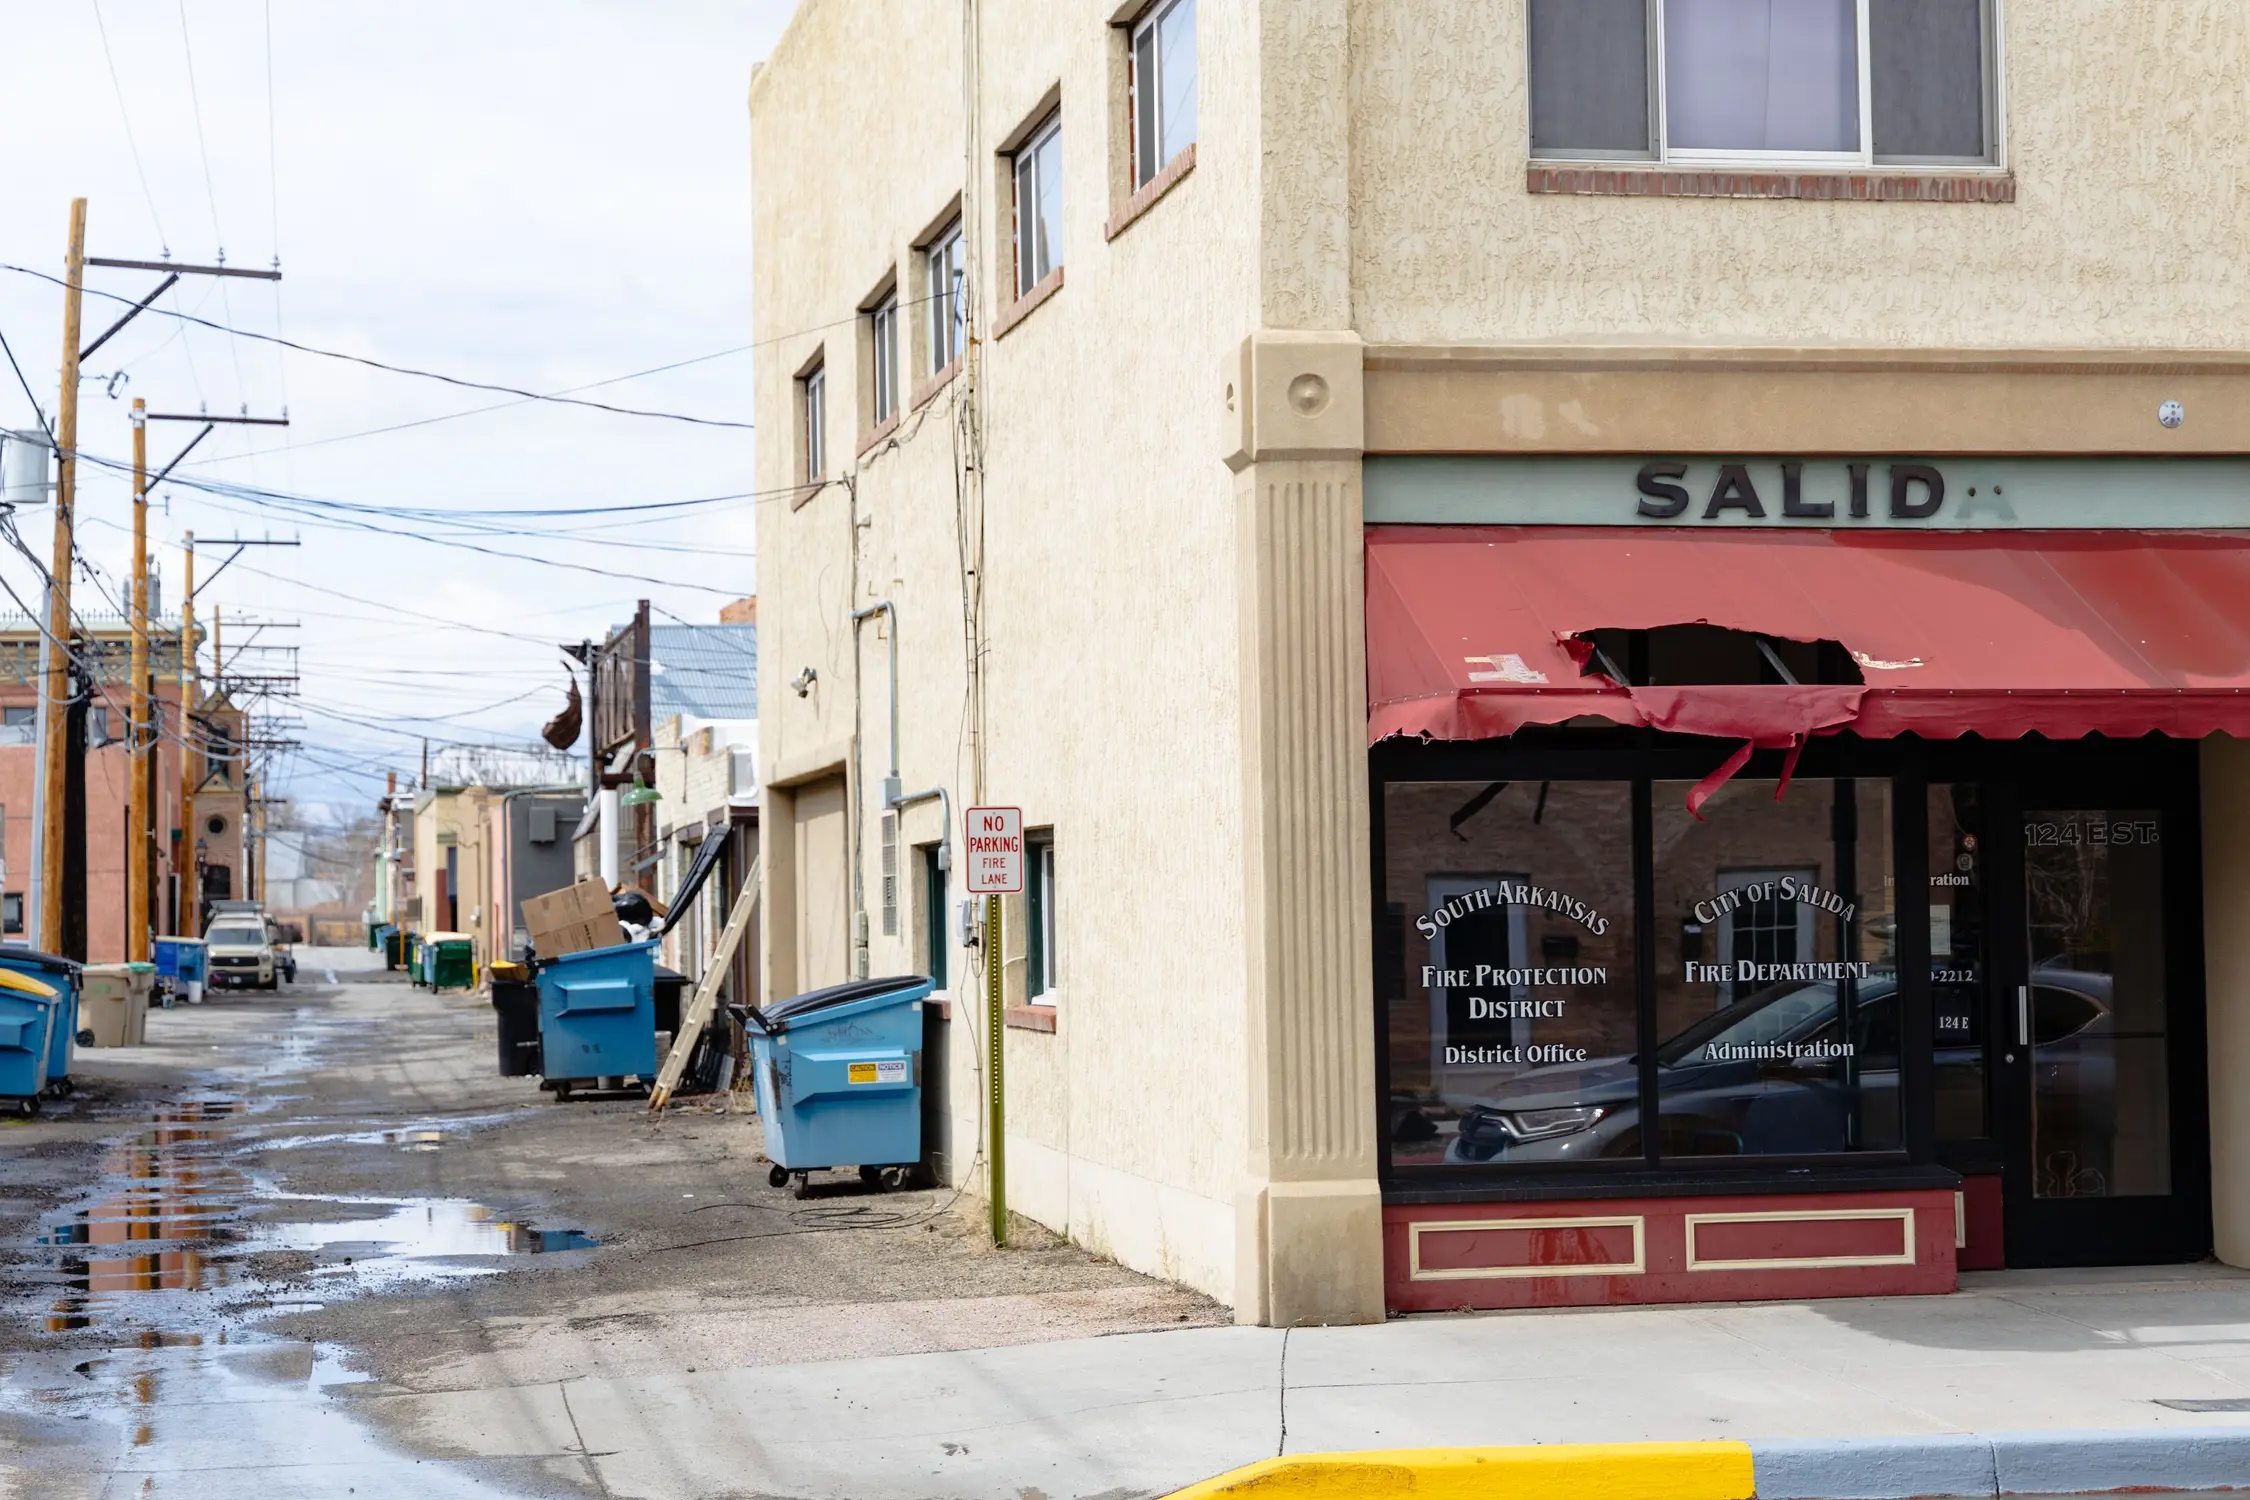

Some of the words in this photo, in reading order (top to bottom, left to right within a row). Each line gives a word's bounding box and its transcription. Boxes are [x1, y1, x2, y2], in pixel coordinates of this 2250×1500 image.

[983, 815, 1004, 832] NO
[2024, 822, 2082, 846] 124
[969, 836, 1018, 853] PARKING
[982, 857, 1006, 868] FIRE
[981, 873, 1007, 885] LANE
[1930, 873, 1969, 886] ration
[1415, 888, 1492, 940] SOUTH
[1496, 880, 1610, 936] ARKANSAS
[1694, 888, 1744, 924] CITY
[1747, 881, 1775, 903] OF
[1779, 876, 1856, 922] SALIDA
[1421, 965, 1470, 988] FIRE
[1475, 964, 1607, 987] PROTECTION
[1684, 960, 1733, 983] FIRE
[1737, 959, 1871, 982] DEPARTMENT
[1468, 996, 1566, 1019] DISTRICT
[1939, 1016, 1959, 1029] 124
[1962, 1016, 1969, 1029] E
[1444, 1044, 1522, 1064] District
[1527, 1043, 1587, 1063] Office
[1705, 1038, 1855, 1060] Administration
